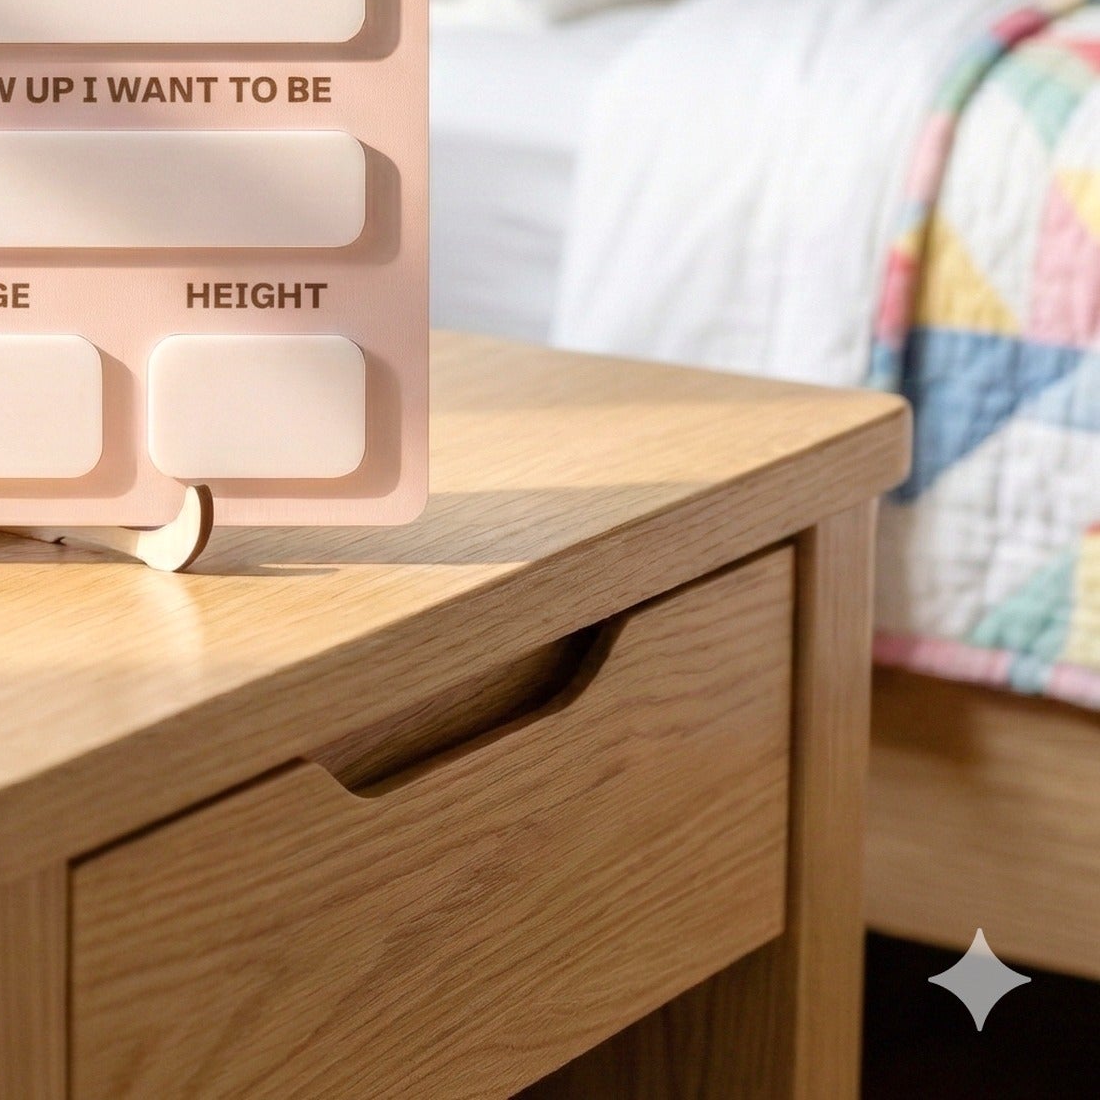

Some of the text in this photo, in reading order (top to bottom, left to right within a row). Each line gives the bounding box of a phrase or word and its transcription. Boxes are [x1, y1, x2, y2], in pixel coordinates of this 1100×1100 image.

[25, 76, 75, 105] UP
[83, 76, 98, 104] I
[107, 76, 219, 104] WANT
[228, 76, 278, 104] TO
[287, 76, 332, 104] BE
[186, 282, 329, 310] HEIGHT
